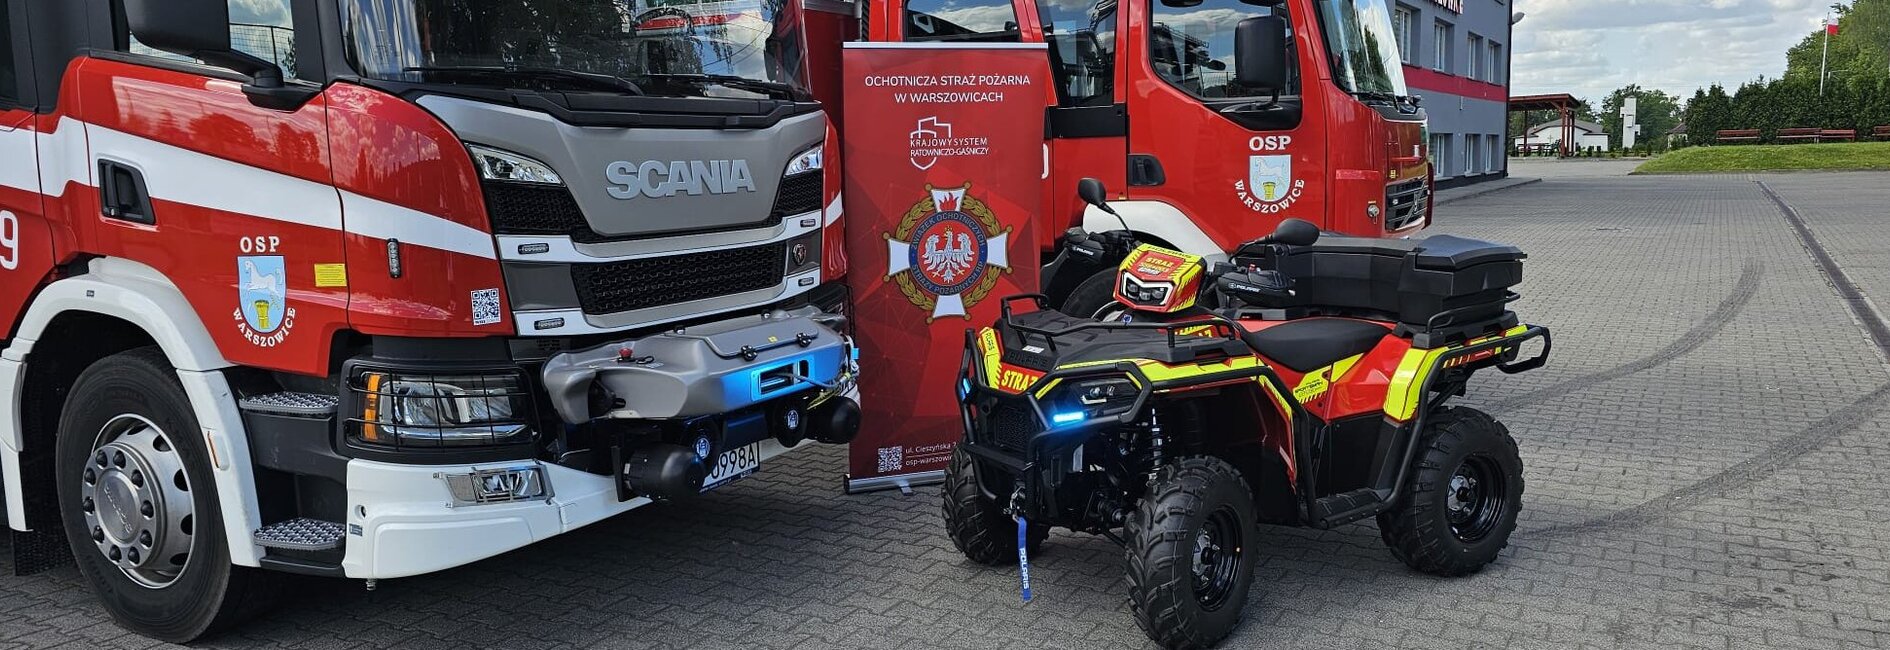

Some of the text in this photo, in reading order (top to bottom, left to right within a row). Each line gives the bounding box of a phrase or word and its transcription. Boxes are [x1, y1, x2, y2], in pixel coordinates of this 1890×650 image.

[865, 73, 1031, 87] OCHOTNICZA STRAŻ POŻARNA
[895, 92, 1003, 103] W WARSZOWICACH
[911, 137, 988, 148] KRAJOWY SYSTEM
[1249, 135, 1292, 151] OSP
[605, 159, 757, 200] SCANIA
[1234, 179, 1305, 213] WARSZOWICE
[240, 236, 280, 253] OSP
[233, 307, 296, 347] WARSZOWICE
[1020, 547, 1030, 590] POLARIS
